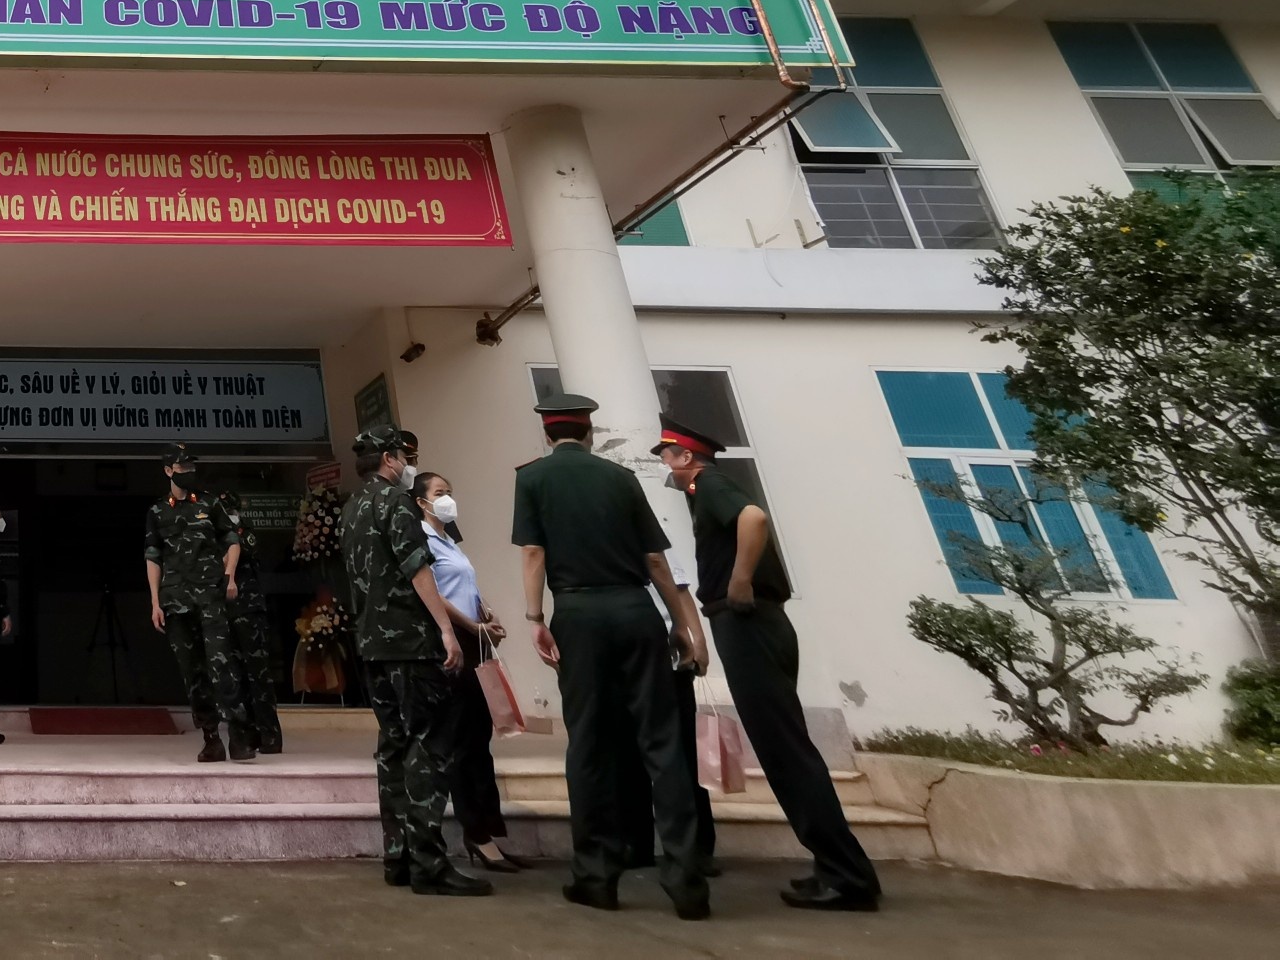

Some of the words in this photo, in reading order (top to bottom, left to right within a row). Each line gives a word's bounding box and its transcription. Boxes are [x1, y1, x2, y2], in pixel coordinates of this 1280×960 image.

[523, 0, 601, 39] ĐỘ
[616, 0, 764, 40] NẶNG
[35, 148, 97, 177] NƯỚC
[105, 153, 182, 178] CHUNG
[190, 150, 242, 183] SỨC,
[248, 148, 311, 180] ĐỒNG
[317, 150, 376, 180] LÒNG
[380, 157, 419, 181] THI
[424, 157, 472, 181] ĐUA
[32, 189, 63, 221] VÀ
[70, 187, 139, 221] CHIẾN
[146, 187, 222, 222] THẮNG
[228, 197, 268, 228] ĐẠI
[275, 198, 331, 229] DỊCH
[337, 199, 446, 224] COVID-19
[20, 371, 54, 394] SÂU
[59, 368, 80, 394] VỀ
[85, 375, 96, 394] Y
[101, 372, 126, 396] LÝ,
[131, 371, 167, 395] GIỎI
[172, 369, 193, 395] VỀ
[197, 376, 208, 395] Y
[213, 373, 265, 399] THUẬT
[38, 405, 74, 427] ĐƠN
[79, 407, 97, 431] VỊ
[102, 404, 149, 428] VỮNG
[155, 408, 207, 432] MẠNH
[212, 405, 256, 429] TOÀN
[262, 405, 302, 433] DIỆN
